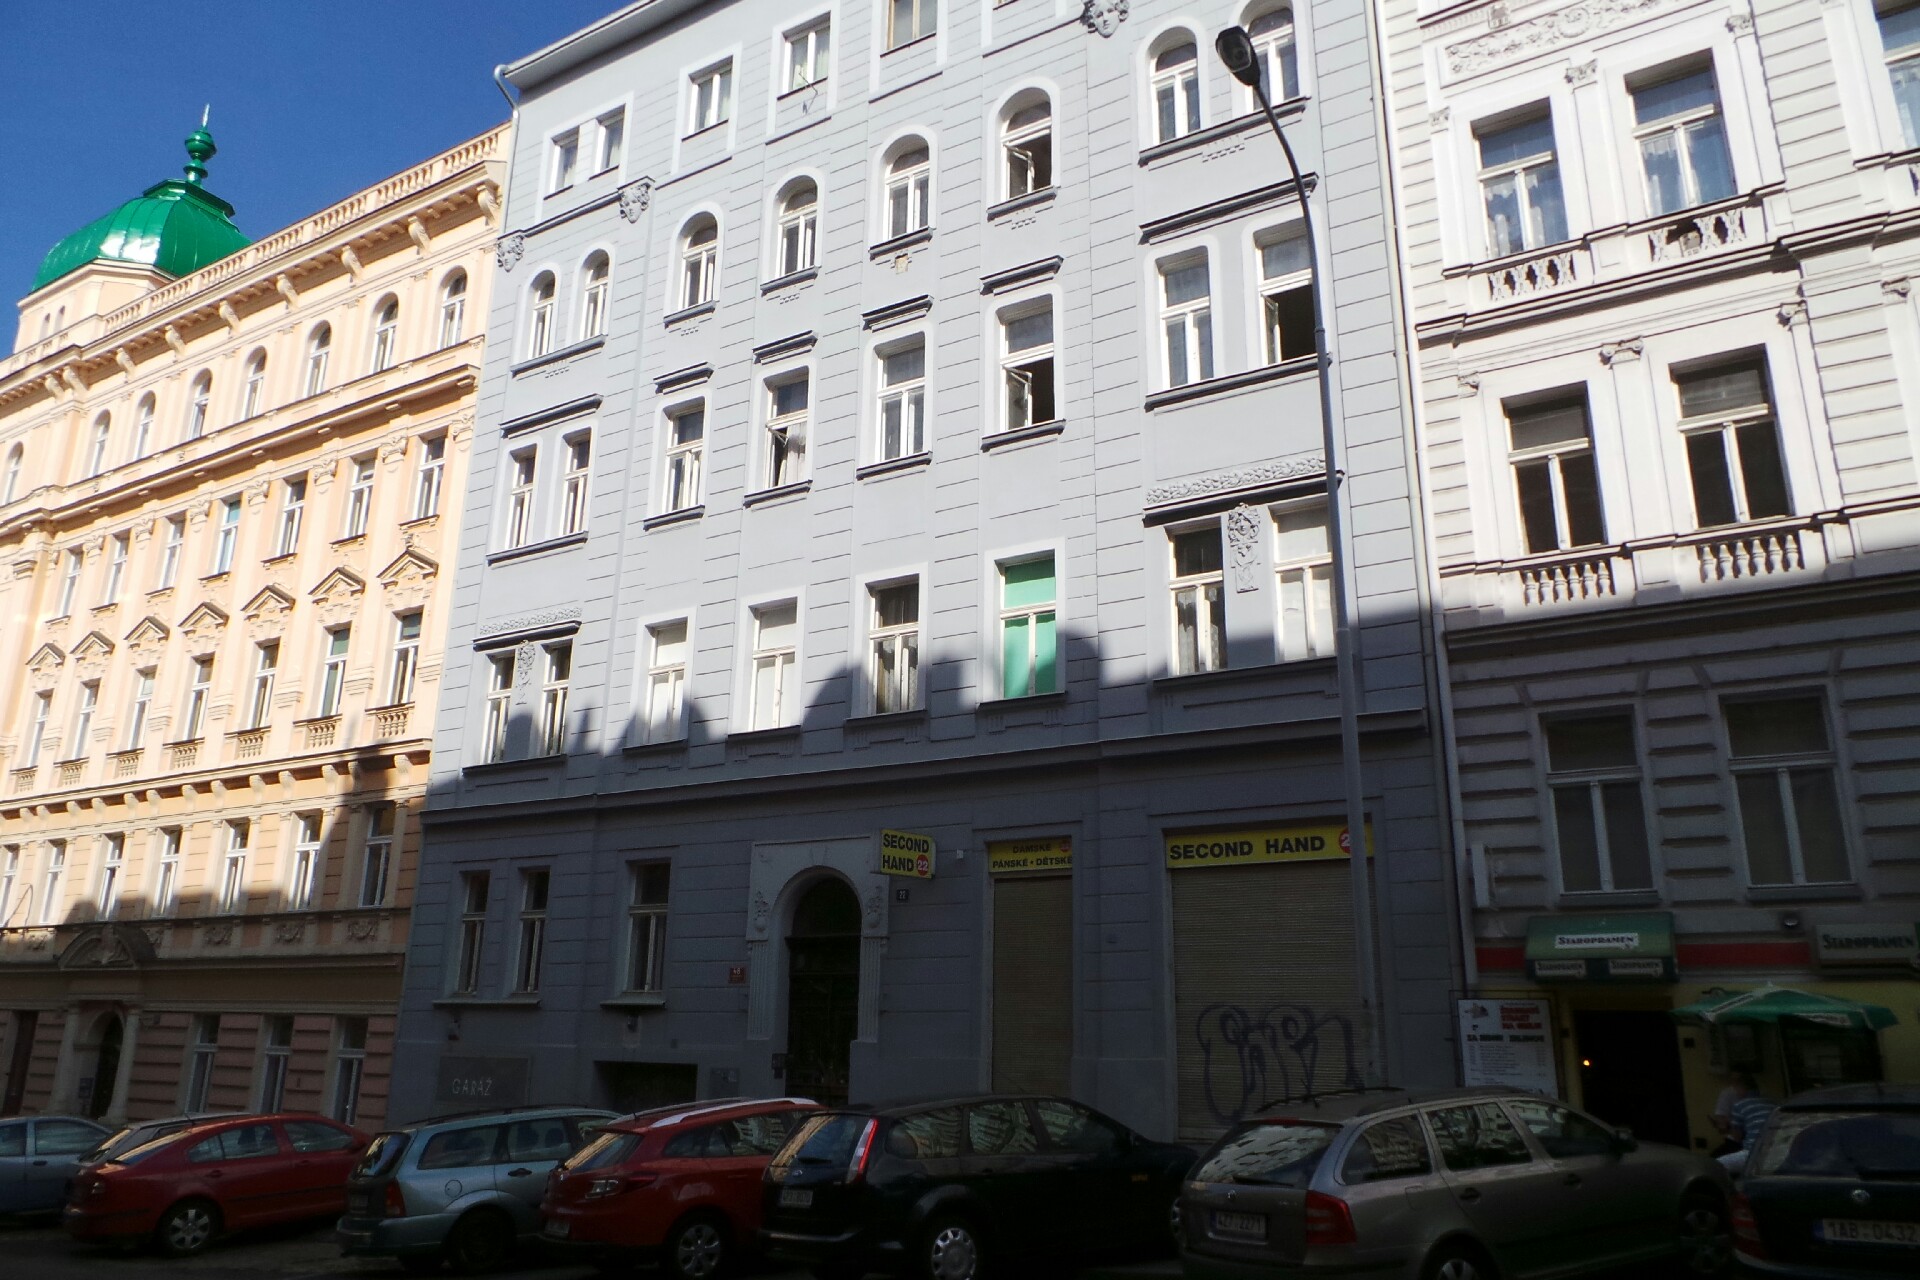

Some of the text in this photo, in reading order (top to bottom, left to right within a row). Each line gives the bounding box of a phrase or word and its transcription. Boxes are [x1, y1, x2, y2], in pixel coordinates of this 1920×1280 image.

[883, 833, 930, 853] SECOND
[1170, 840, 1253, 860] SECOND
[1265, 835, 1325, 854] HAND
[882, 854, 929, 871] HAND 22
